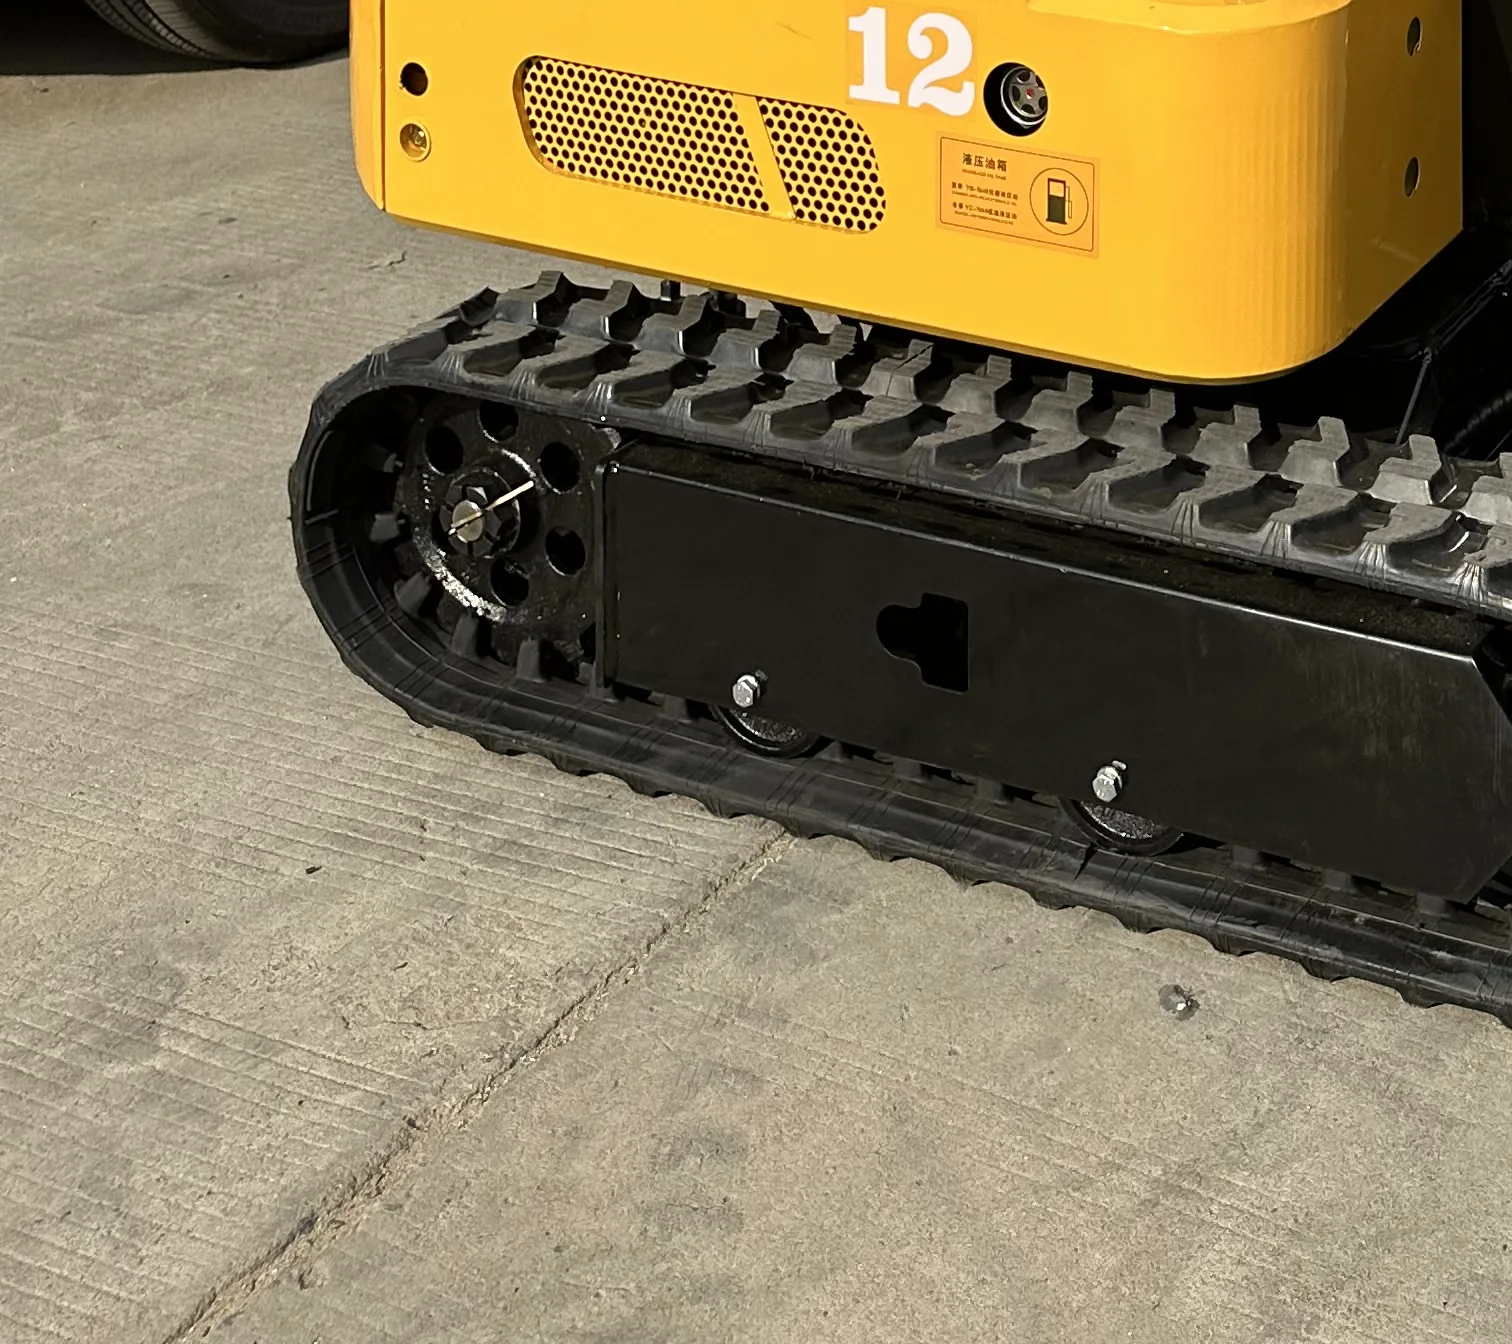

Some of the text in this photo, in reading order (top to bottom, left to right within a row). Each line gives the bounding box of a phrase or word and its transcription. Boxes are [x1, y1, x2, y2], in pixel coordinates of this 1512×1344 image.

[848, 6, 976, 117] 12
[962, 152, 1008, 172] 液压油箱
